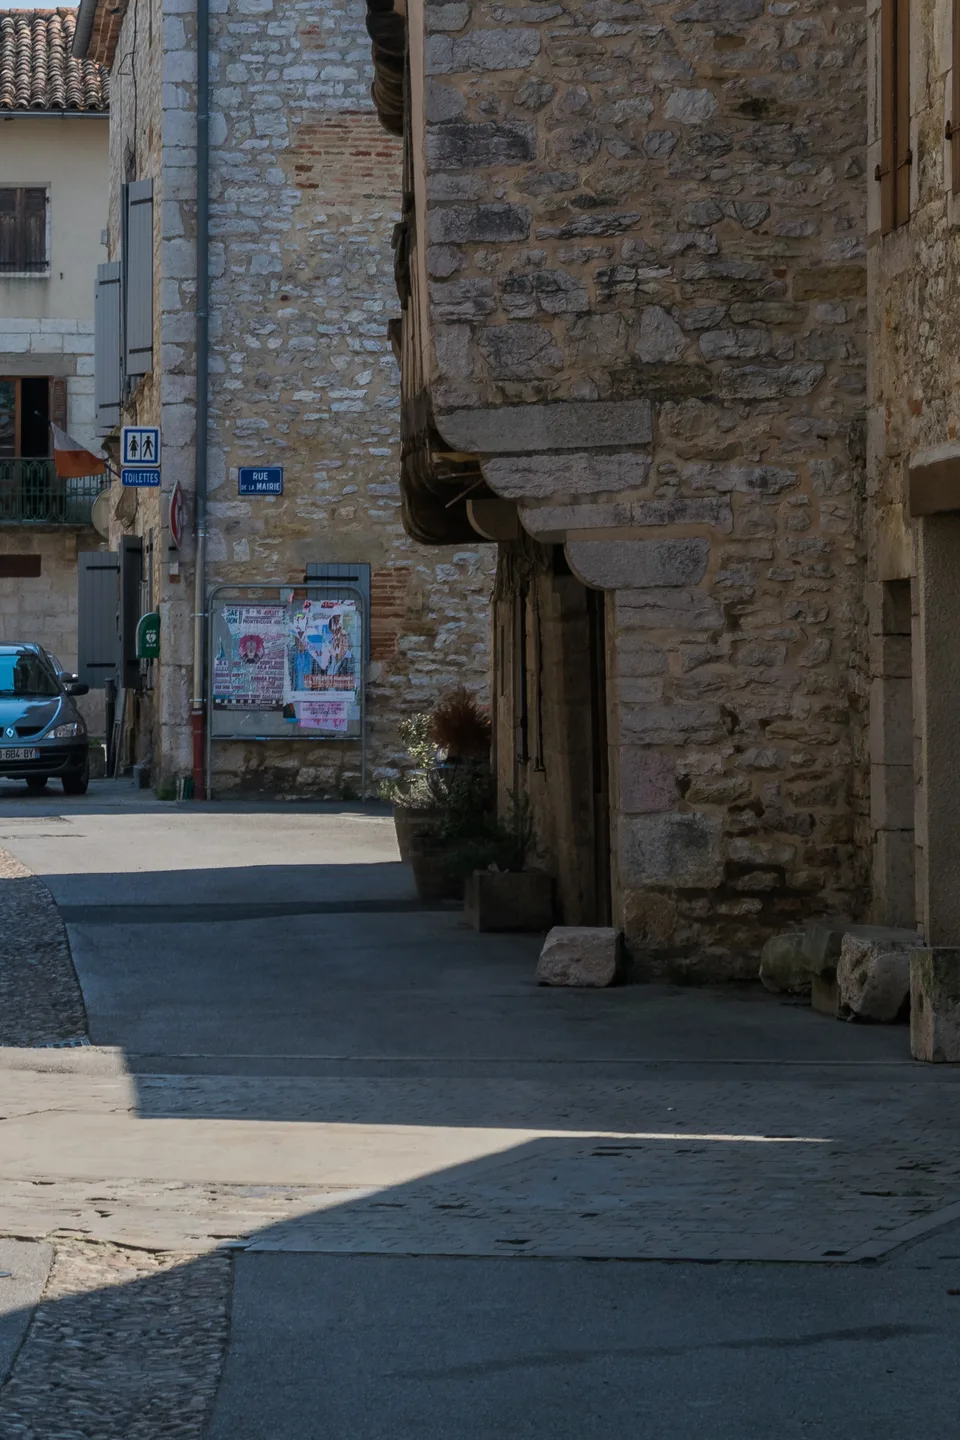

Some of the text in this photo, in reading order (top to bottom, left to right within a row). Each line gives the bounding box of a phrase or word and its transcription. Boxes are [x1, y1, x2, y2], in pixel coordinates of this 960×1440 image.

[124, 473, 159, 483] TOILETTES
[253, 472, 268, 480] RUE
[256, 482, 280, 491] MAIRIE
